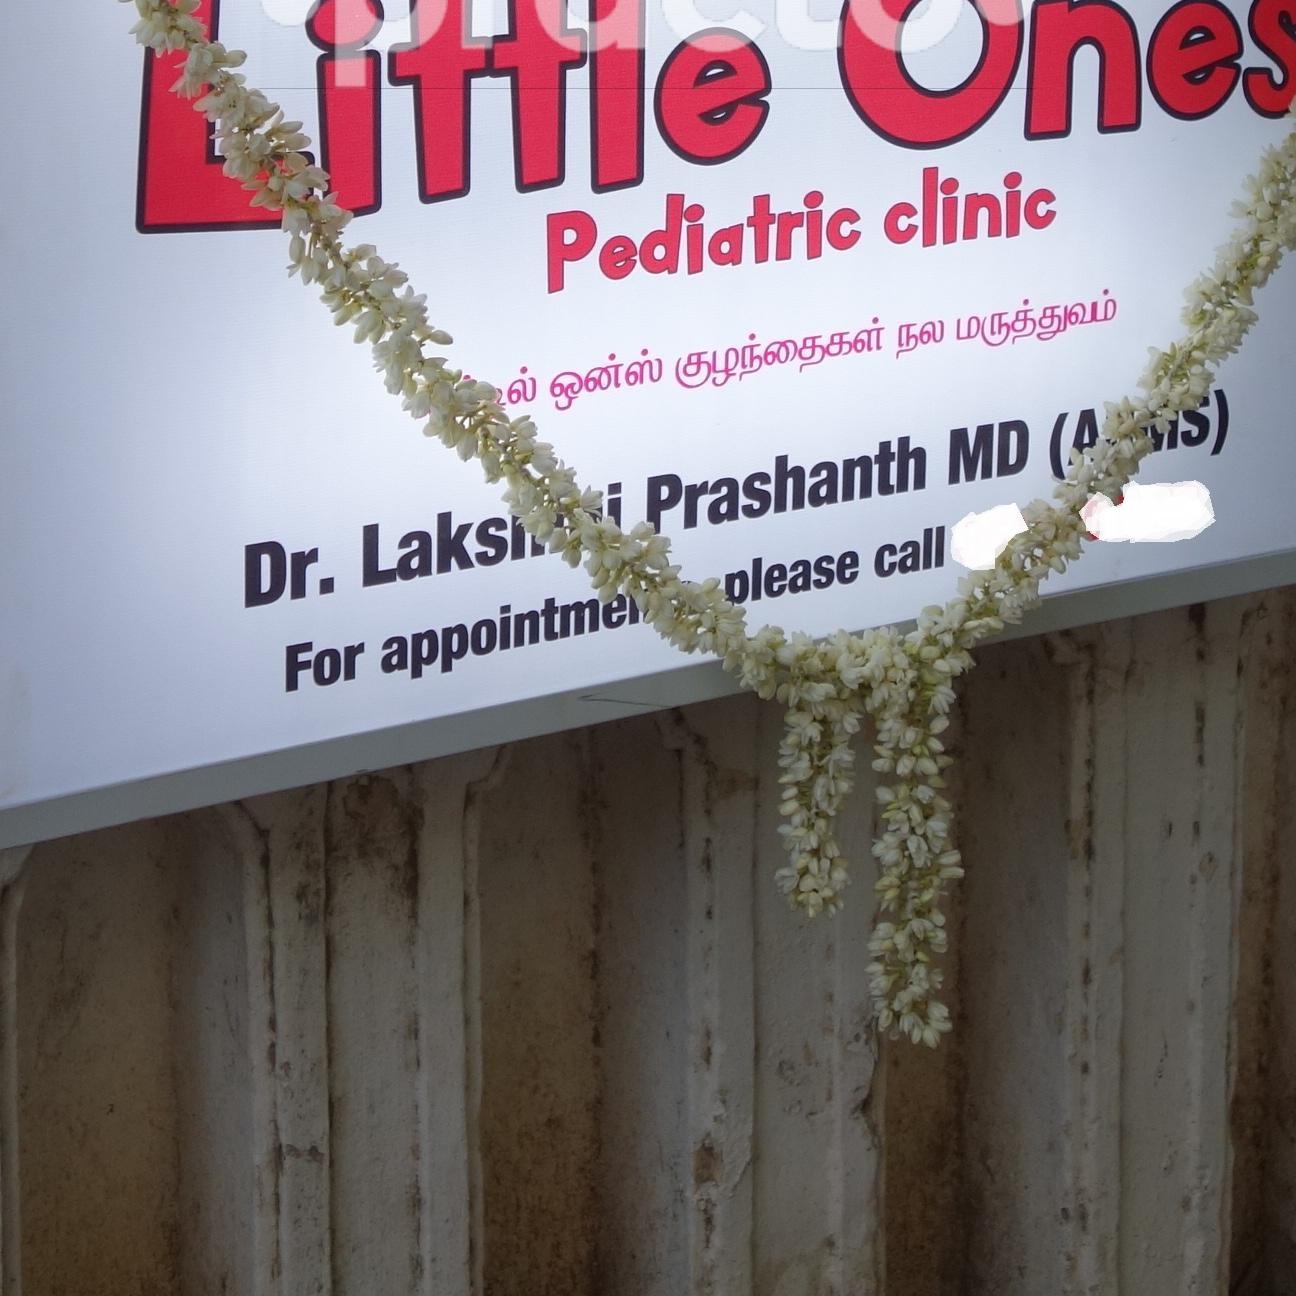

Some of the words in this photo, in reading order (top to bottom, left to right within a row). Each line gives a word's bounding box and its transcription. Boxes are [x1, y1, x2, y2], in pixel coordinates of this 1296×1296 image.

[546, 190, 862, 294] Pediatric
[883, 166, 1057, 248] clinic
[674, 316, 884, 389] குழந்தைகள்
[895, 319, 945, 360] நல
[956, 288, 1117, 344] மருத்துவம்
[244, 540, 335, 608] Dr.
[646, 436, 926, 535] Prashanth
[948, 419, 1029, 485] MD
[285, 641, 365, 692] For
[725, 550, 859, 607] please
[874, 526, 945, 580] call
